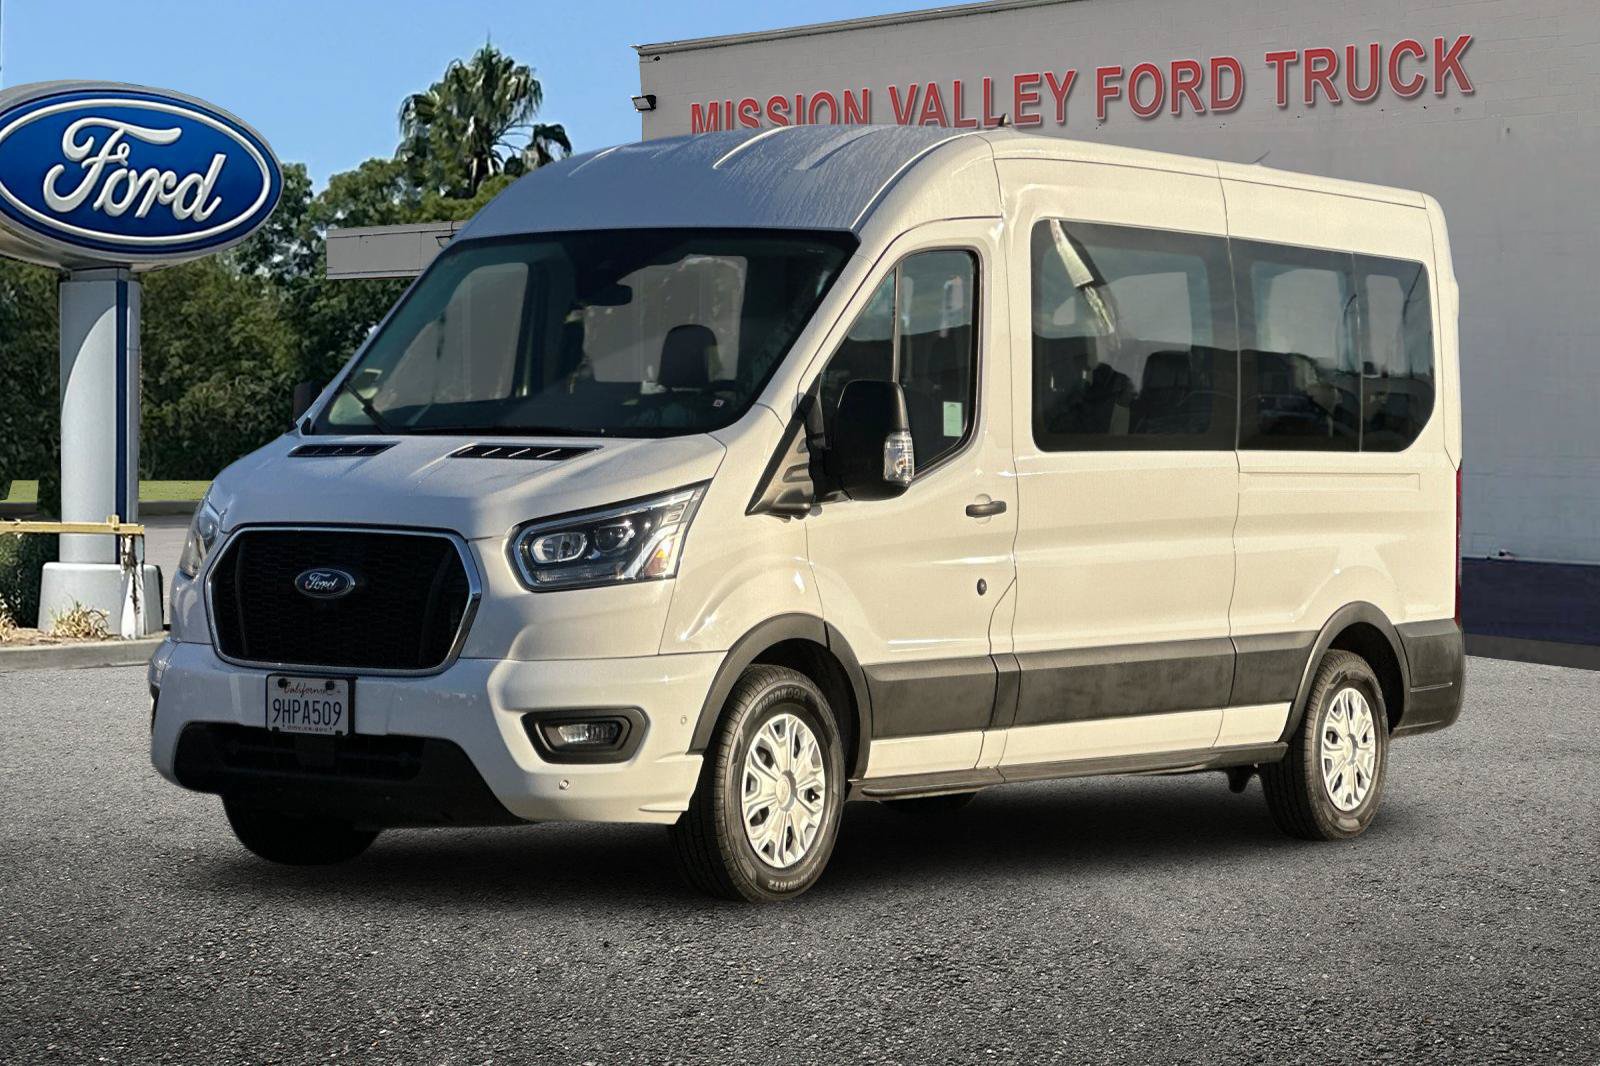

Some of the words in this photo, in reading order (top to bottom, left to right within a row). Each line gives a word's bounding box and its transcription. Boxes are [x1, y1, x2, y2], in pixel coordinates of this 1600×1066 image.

[690, 87, 871, 135] MISSION
[888, 69, 1078, 128] VALLEY
[1096, 55, 1244, 120] FORD
[1264, 34, 1474, 107] TRUCK
[43, 117, 227, 222] Ford
[304, 572, 338, 591] Ford
[272, 698, 342, 727] 9HPA509
